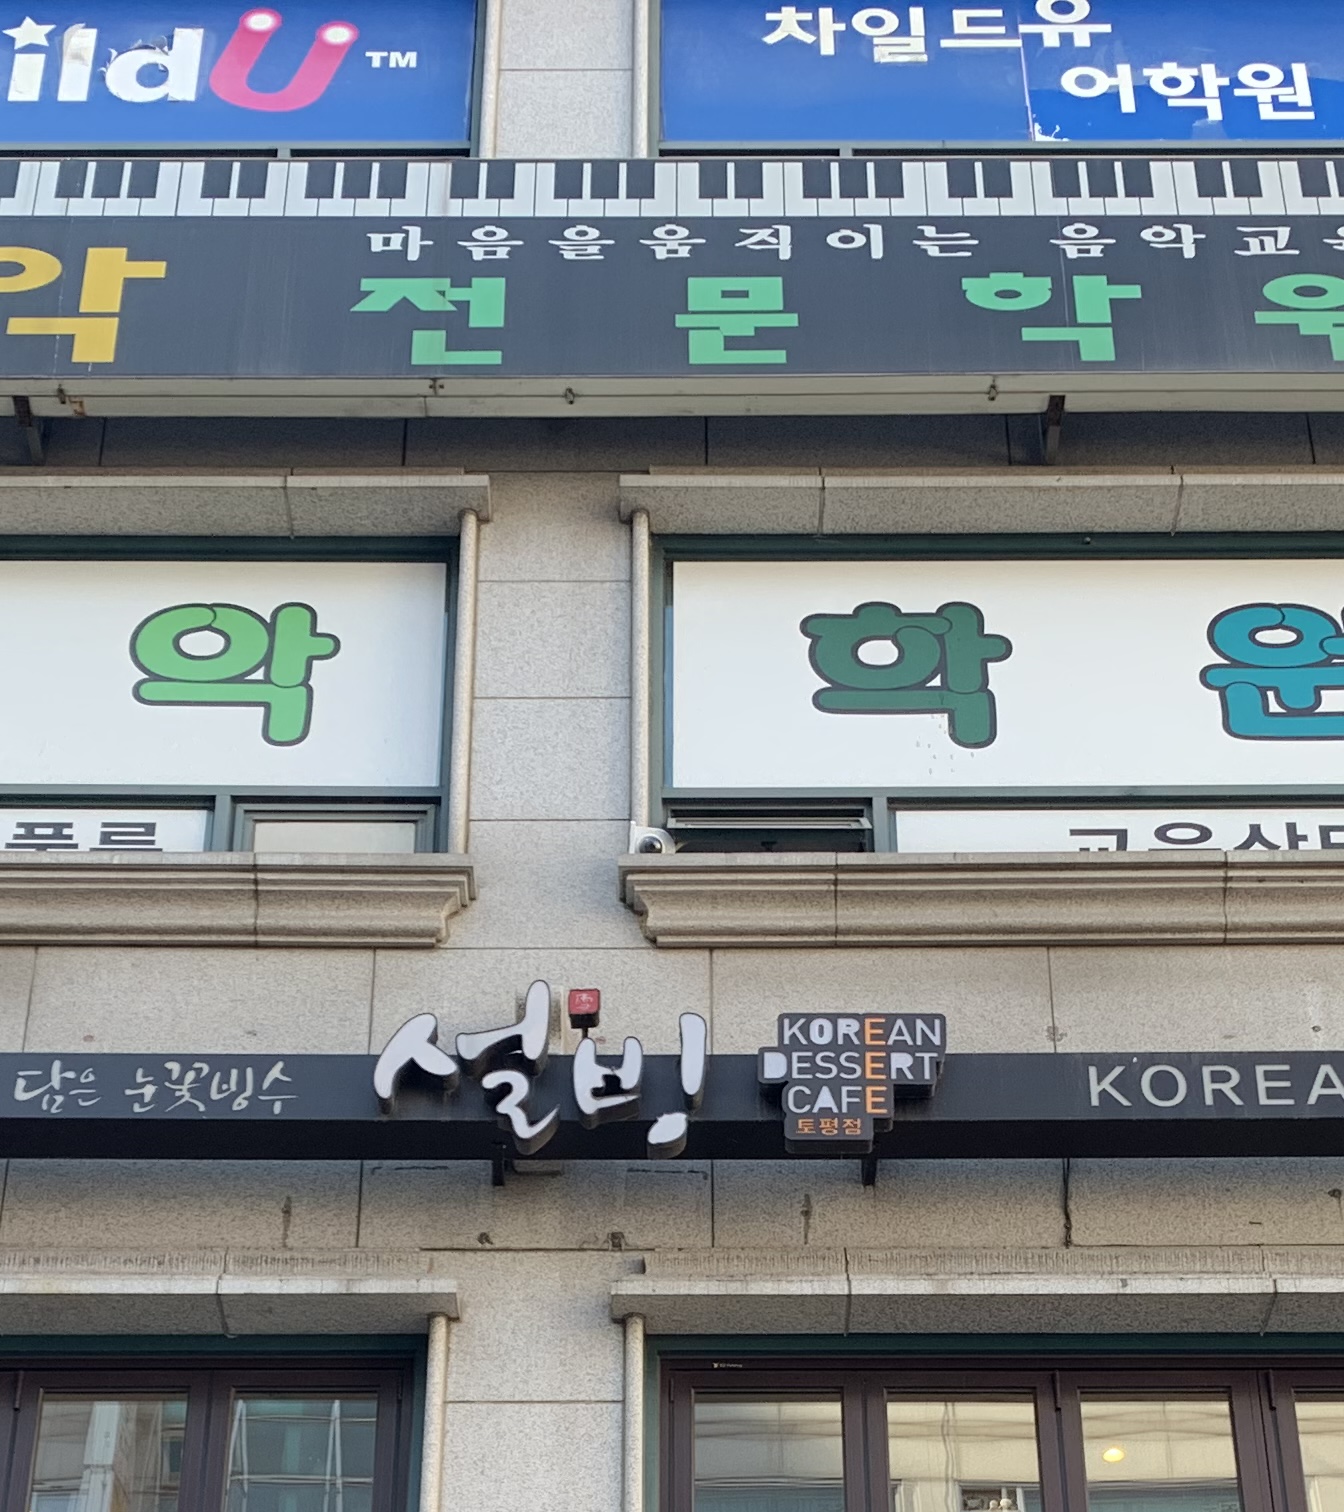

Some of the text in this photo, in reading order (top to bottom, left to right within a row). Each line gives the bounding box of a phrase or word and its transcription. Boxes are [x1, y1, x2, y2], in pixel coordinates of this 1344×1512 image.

[762, 0, 1111, 62] 차일드유
[1061, 62, 1315, 121] 어학원
[782, 1017, 942, 1047] KOREAN
[373, 979, 706, 1147] 설빙
[763, 1051, 938, 1081] DESSERT
[13, 1060, 102, 1114] 담은
[123, 1060, 299, 1115] 눈꽃빙수
[787, 1085, 887, 1115] CAFE
[794, 1117, 863, 1136] 토평점
